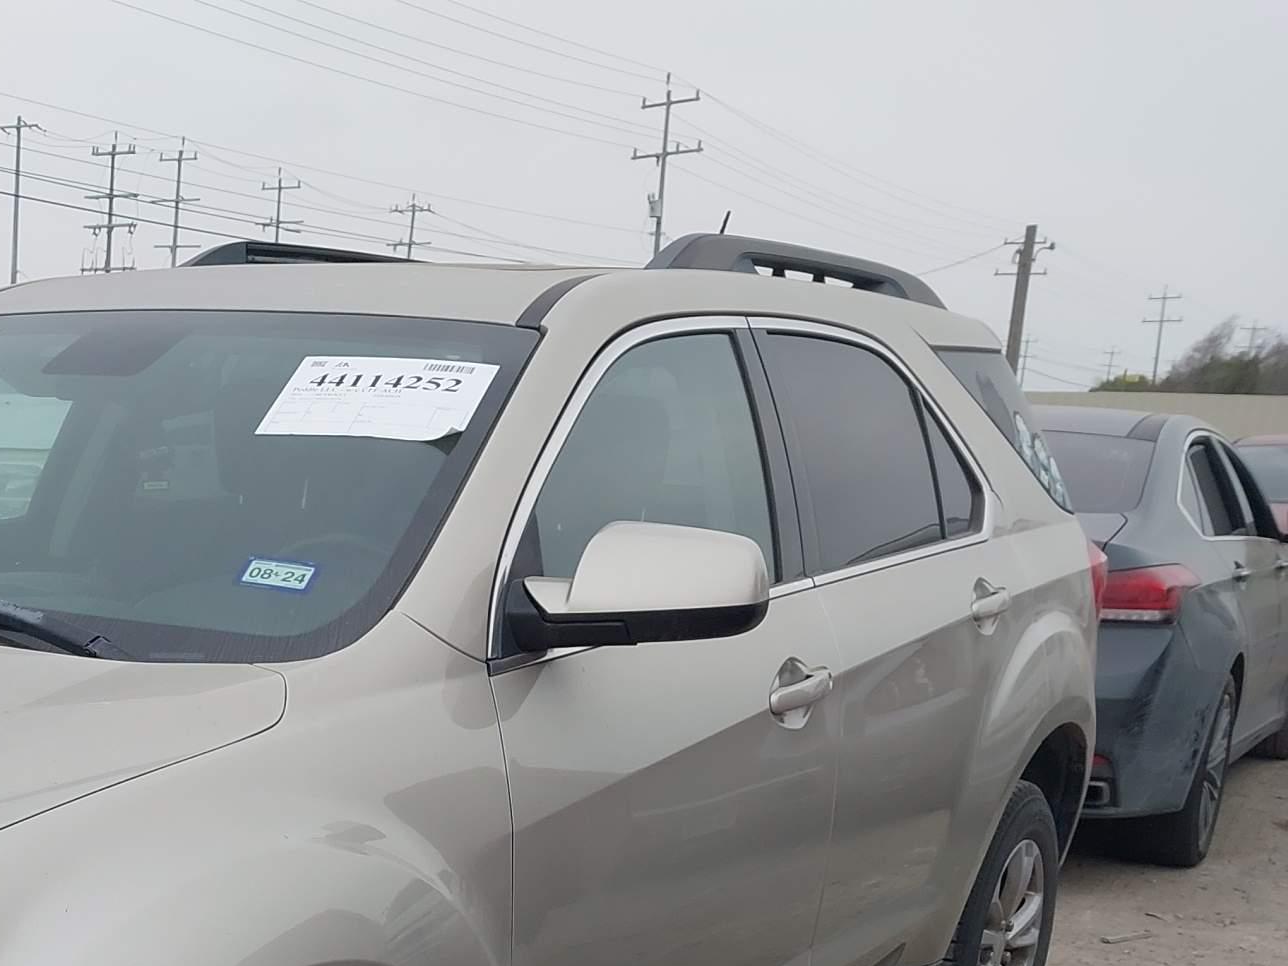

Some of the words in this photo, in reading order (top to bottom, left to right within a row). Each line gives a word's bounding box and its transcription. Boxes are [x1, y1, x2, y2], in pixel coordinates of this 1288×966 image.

[309, 373, 463, 392] 44114252
[249, 567, 273, 580] 08
[280, 571, 306, 584] 24
